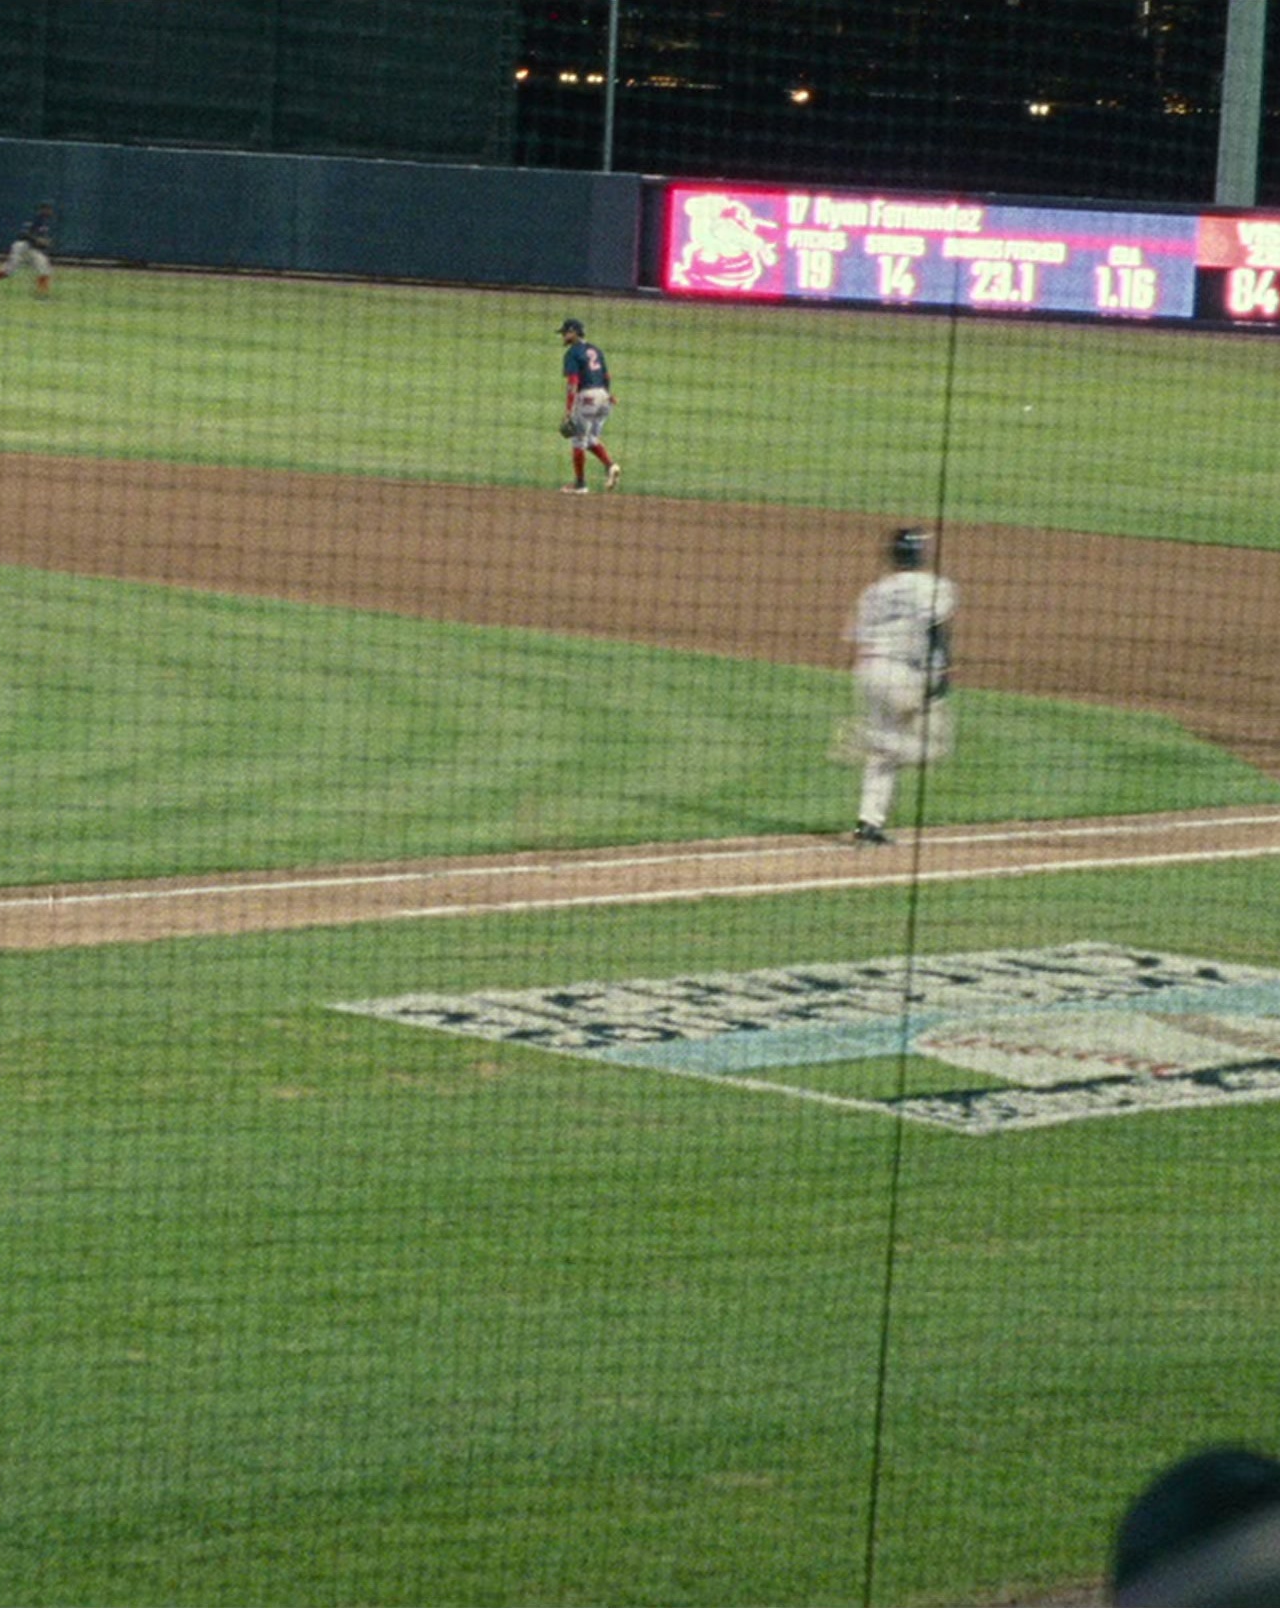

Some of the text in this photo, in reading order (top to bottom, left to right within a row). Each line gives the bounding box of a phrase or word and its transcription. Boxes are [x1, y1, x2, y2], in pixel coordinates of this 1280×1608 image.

[787, 196, 810, 224] 17
[869, 199, 982, 232] Fernandez
[797, 250, 834, 290] 19
[877, 255, 916, 297] 14
[970, 260, 1036, 303] 23.1
[1095, 266, 1157, 311] 1.16
[1230, 267, 1280, 315] 84
[585, 347, 601, 371] 2
